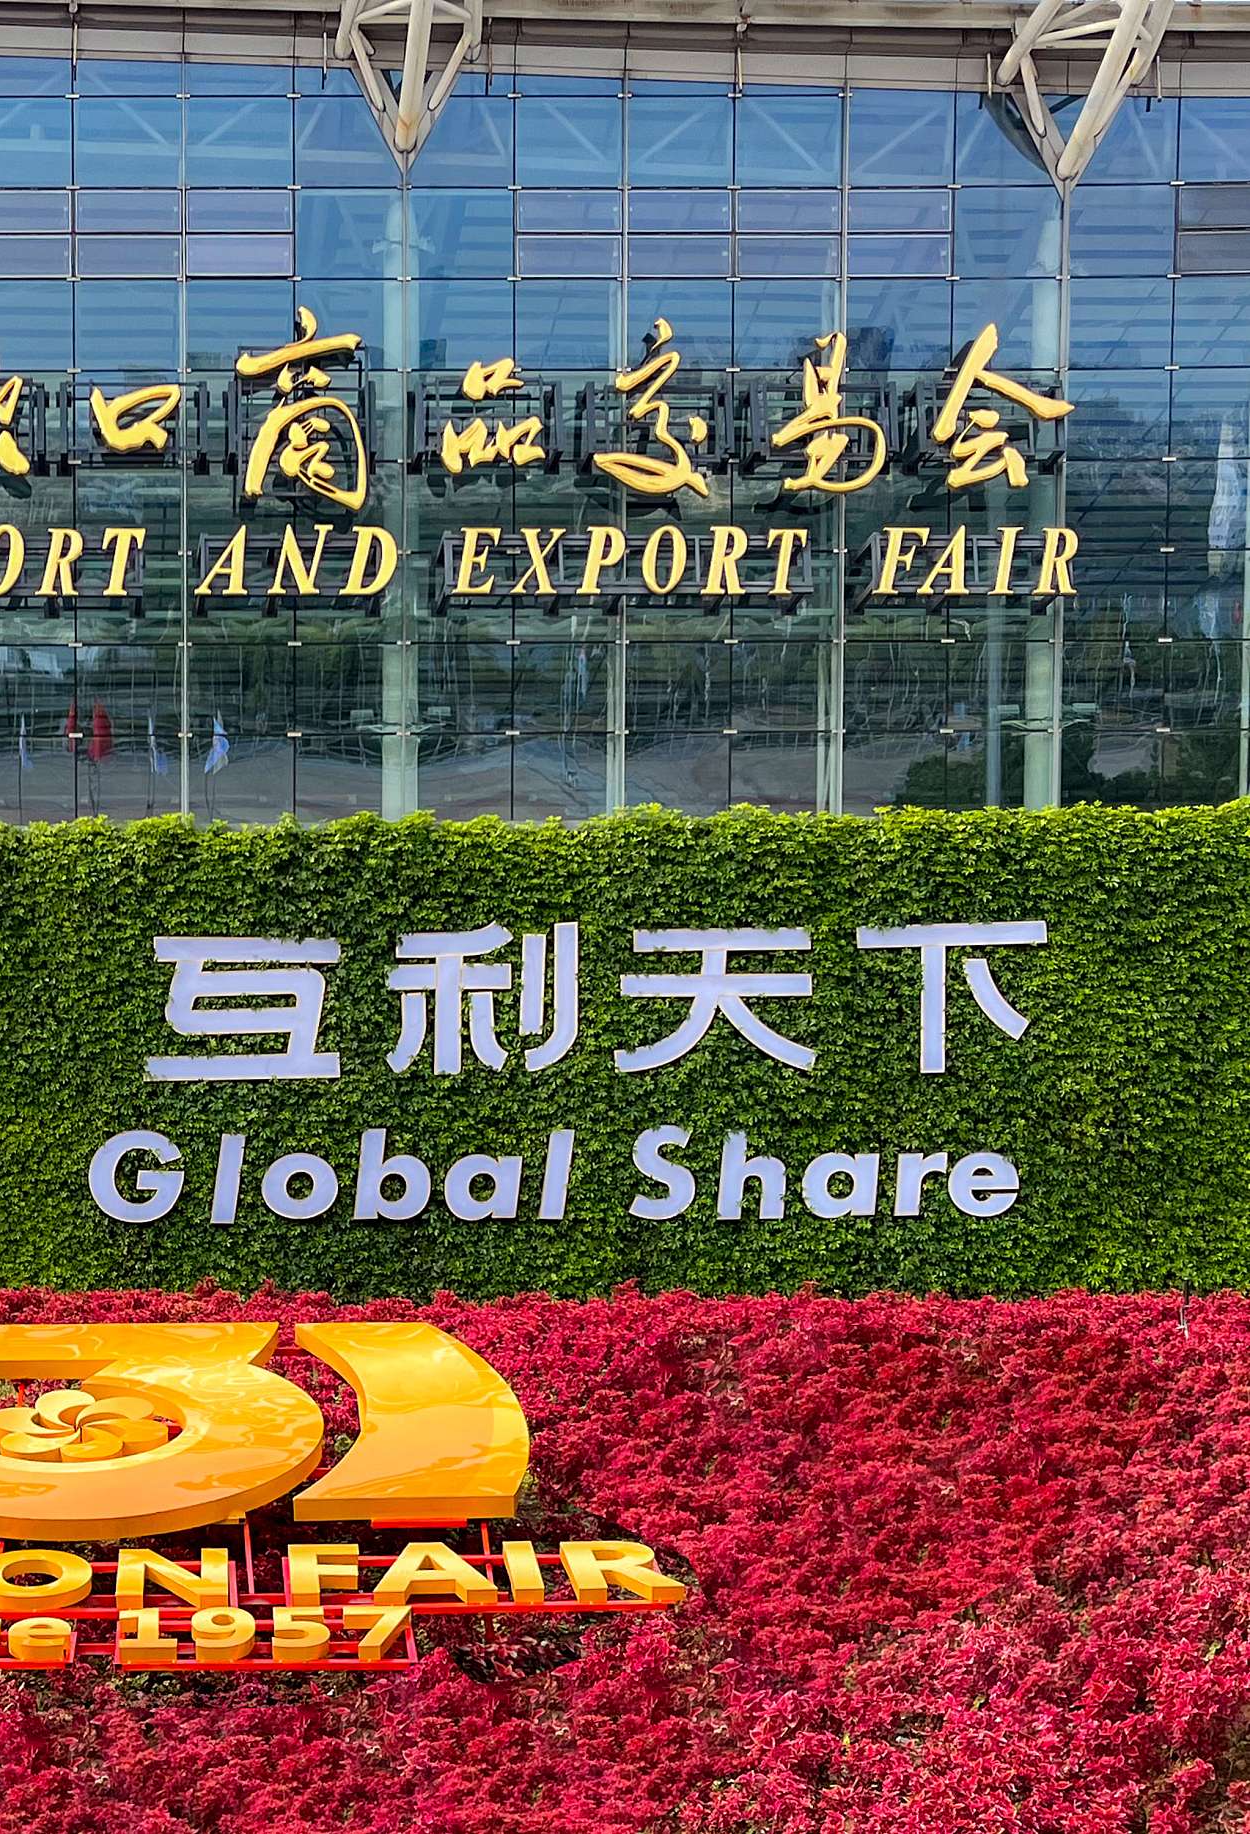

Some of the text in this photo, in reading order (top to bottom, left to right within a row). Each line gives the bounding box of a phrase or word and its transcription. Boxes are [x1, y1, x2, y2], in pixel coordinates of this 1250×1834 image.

[197, 523, 399, 598] AND
[451, 523, 810, 598] EXPORT
[871, 523, 1080, 598] FAIR
[143, 919, 1049, 1083] 互利天下
[87, 1127, 576, 1225] Global
[627, 1123, 1022, 1221] Share
[284, 1539, 687, 1607] FAIR
[116, 1604, 414, 1664] 1957
